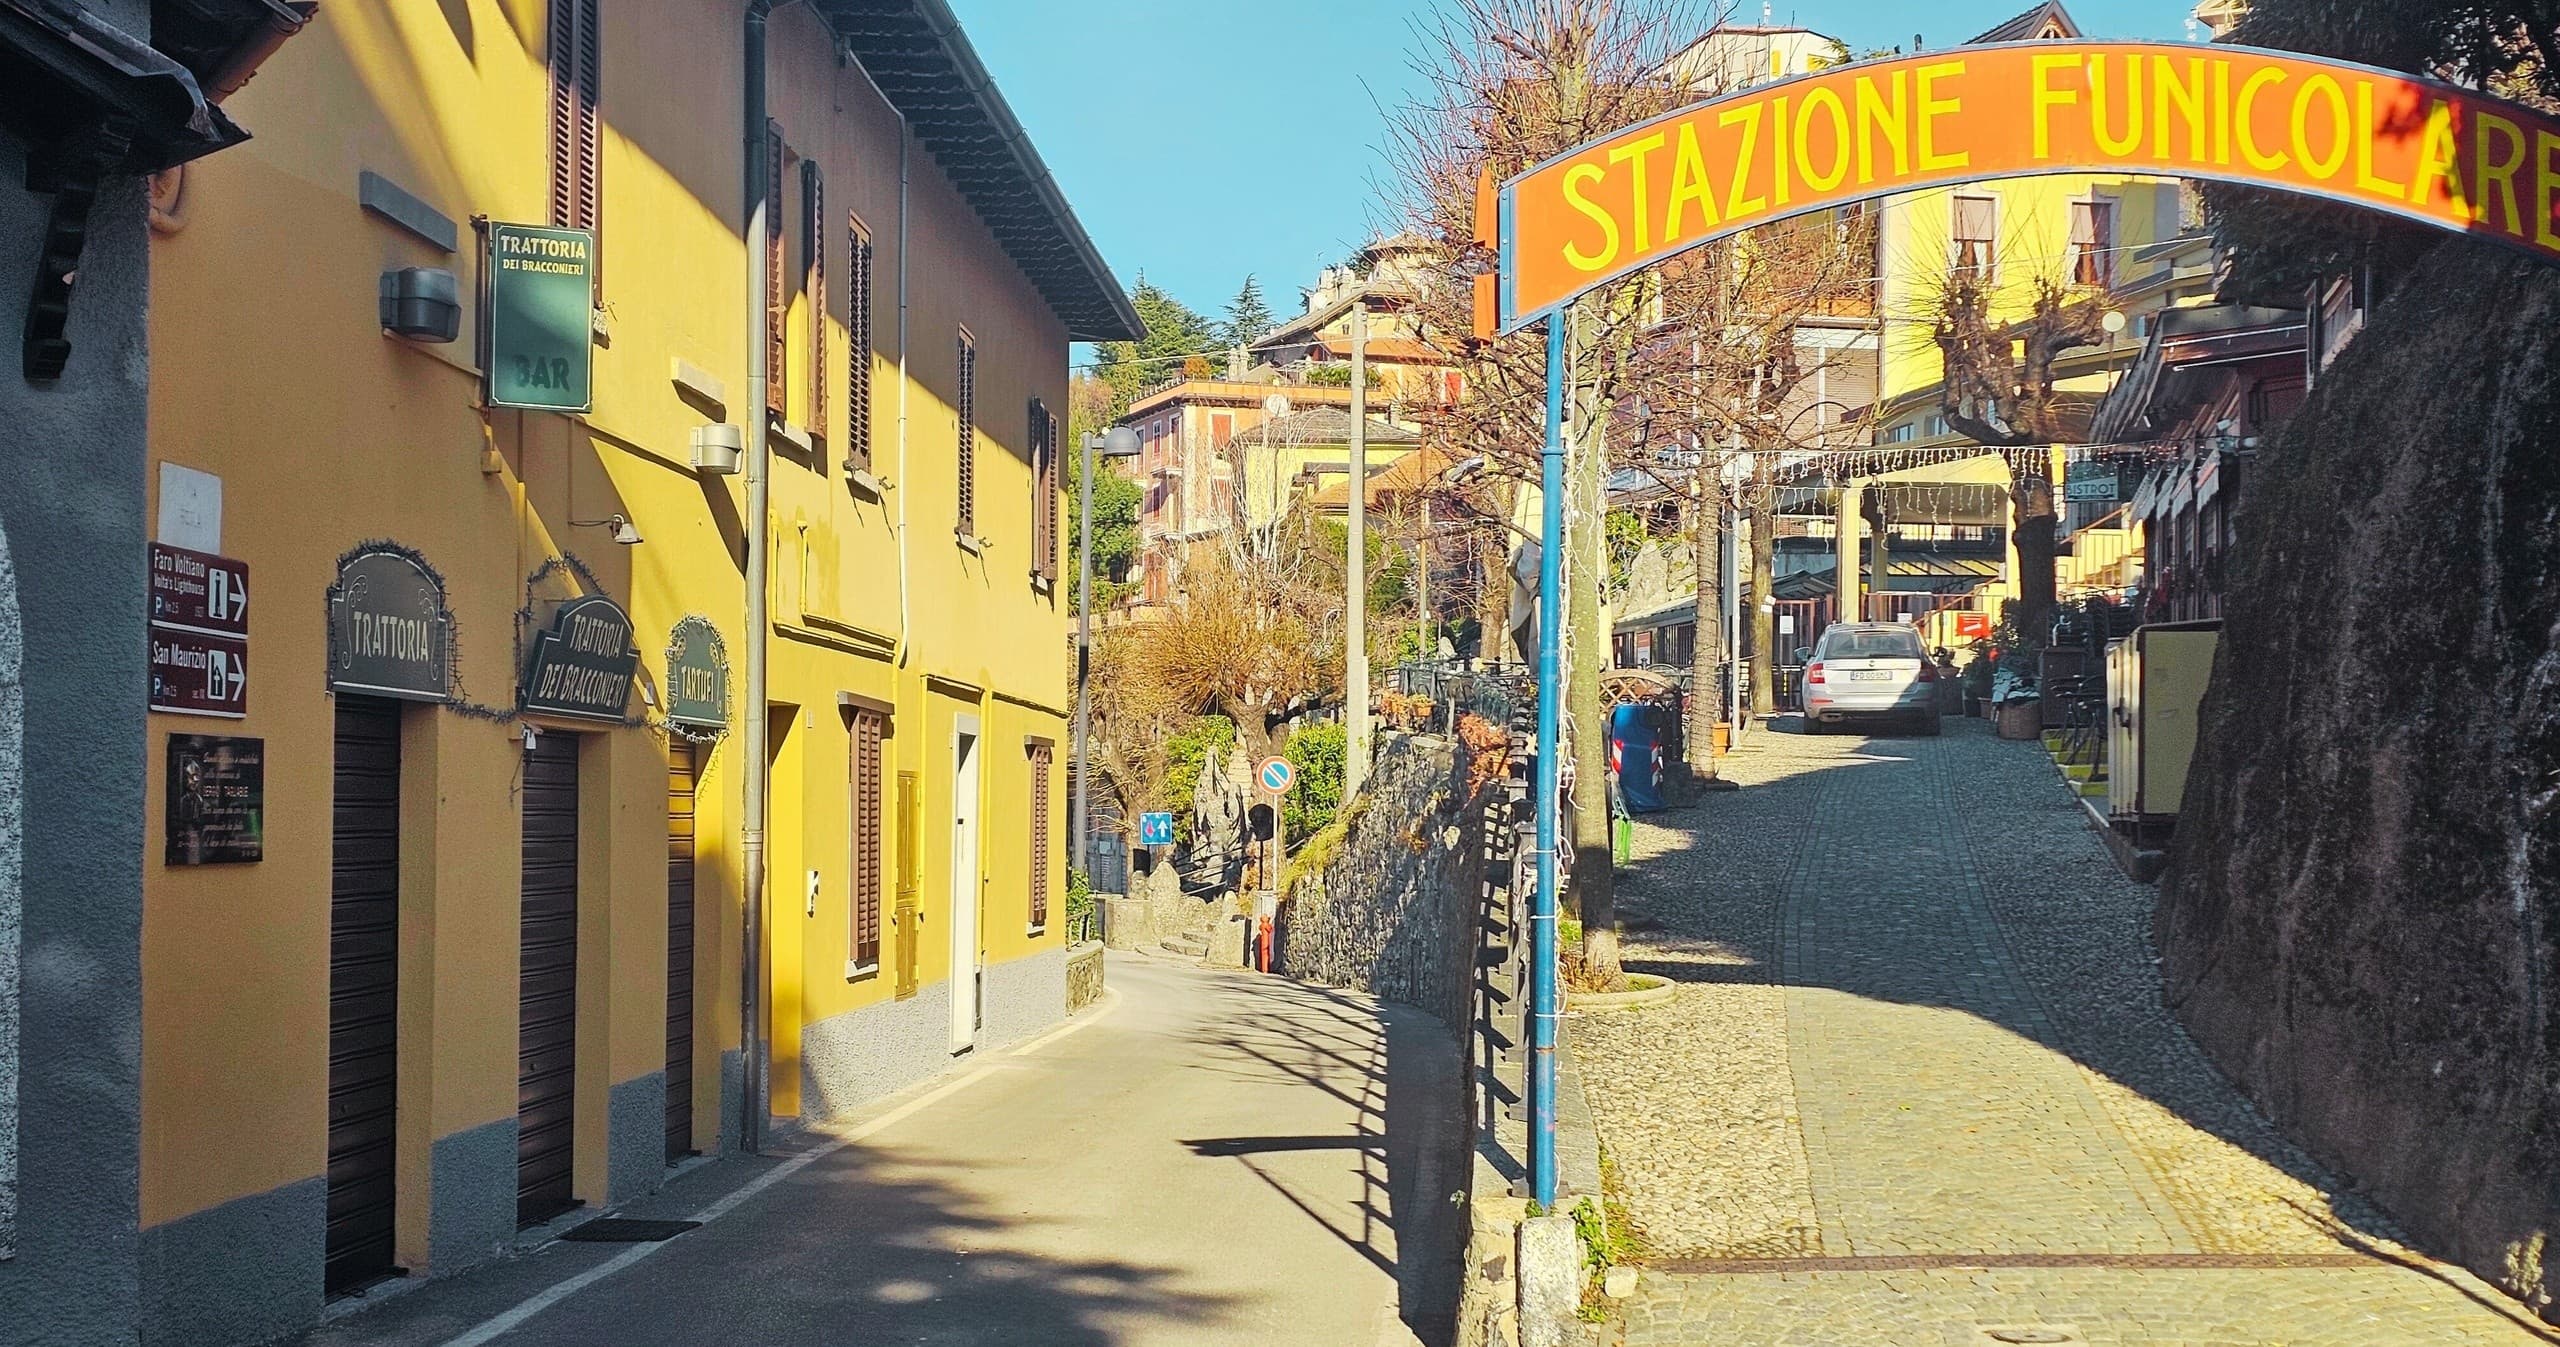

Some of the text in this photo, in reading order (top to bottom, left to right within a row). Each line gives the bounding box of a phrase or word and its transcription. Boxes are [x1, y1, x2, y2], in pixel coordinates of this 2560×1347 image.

[1562, 52, 2560, 272] STAZIONE FUNICOLARE
[501, 234, 586, 260] TRATTORIA
[503, 258, 584, 275] DEI BRACCONIERI
[514, 355, 570, 392] BAR
[2066, 483, 2117, 495] BISTROT
[154, 548, 205, 578] Faro Voltiano
[153, 572, 205, 596] Volta's Lighthouse
[352, 610, 429, 663] TRATTORIA
[570, 614, 624, 658] TRATTORIA
[153, 640, 206, 670] San Maurizio
[538, 663, 628, 708] DEI BRACCONIERI
[681, 665, 714, 703] TARTUFI
